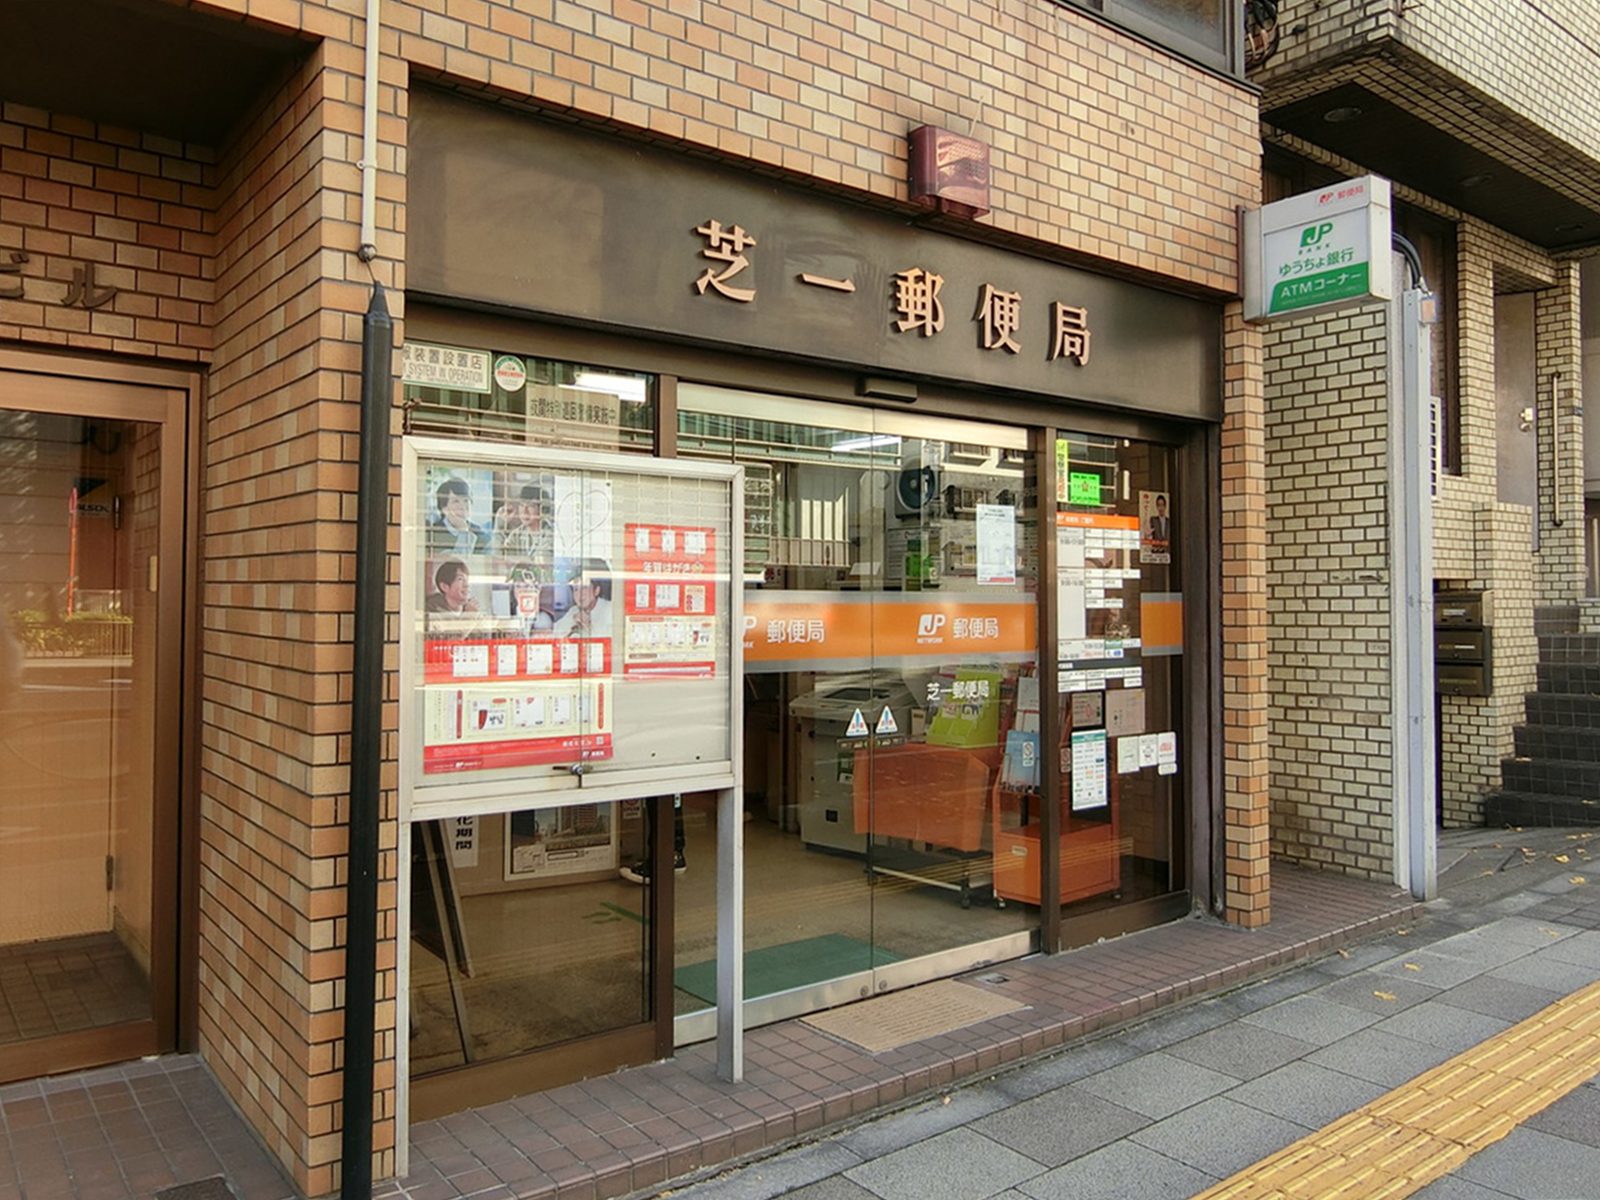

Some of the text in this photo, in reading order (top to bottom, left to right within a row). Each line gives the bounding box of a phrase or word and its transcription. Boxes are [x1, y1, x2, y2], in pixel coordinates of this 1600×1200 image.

[1338, 185, 1364, 200] 郵便局
[1300, 222, 1333, 247] JP
[1279, 247, 1354, 276] ゆうちょ銀行
[695, 218, 1092, 367] 芝一郵便局
[1280, 272, 1362, 298] ATMコーナー
[767, 619, 825, 644] 郵便局
[952, 617, 1000, 640] 郵便局
[926, 679, 990, 701] 芝一郵便局
